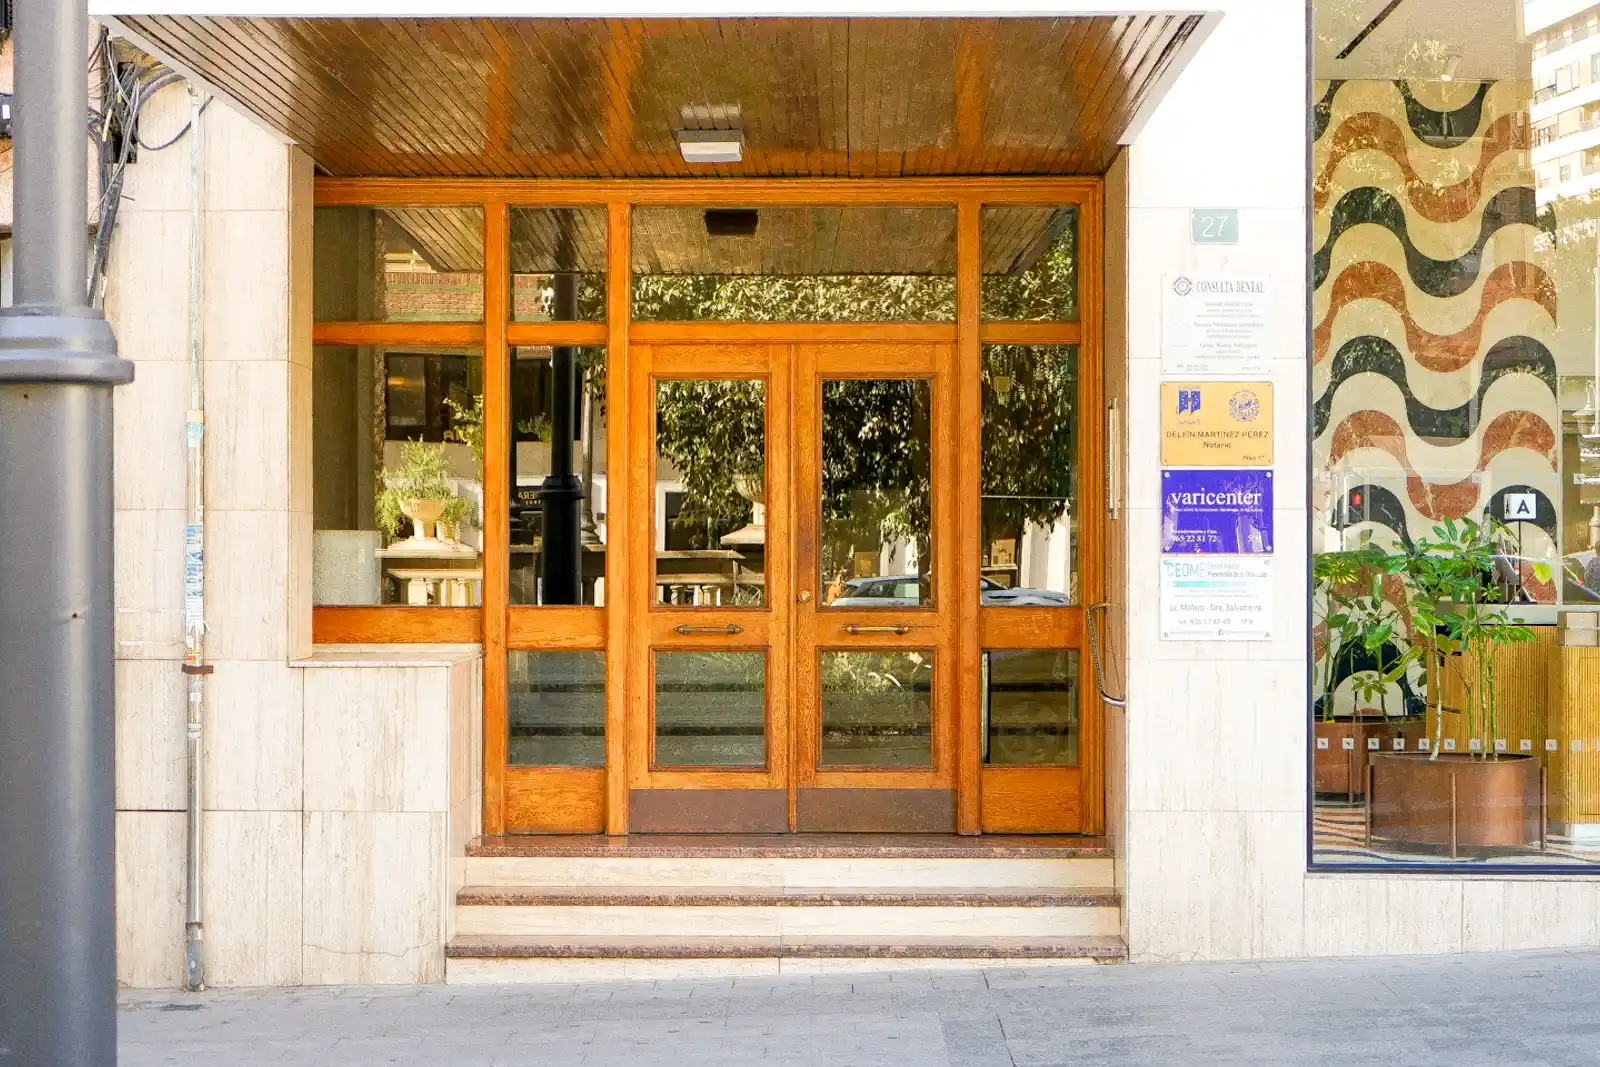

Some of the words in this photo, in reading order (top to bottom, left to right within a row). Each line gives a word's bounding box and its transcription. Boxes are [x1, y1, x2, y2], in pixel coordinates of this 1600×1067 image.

[1201, 216, 1228, 237] 27
[1196, 281, 1234, 293] CONSULTA
[1236, 281, 1266, 293] DENTAL
[1203, 441, 1232, 449] Notario
[1170, 487, 1262, 505] varicenter
[1516, 499, 1530, 514] A
[1179, 603, 1205, 612] Molero
